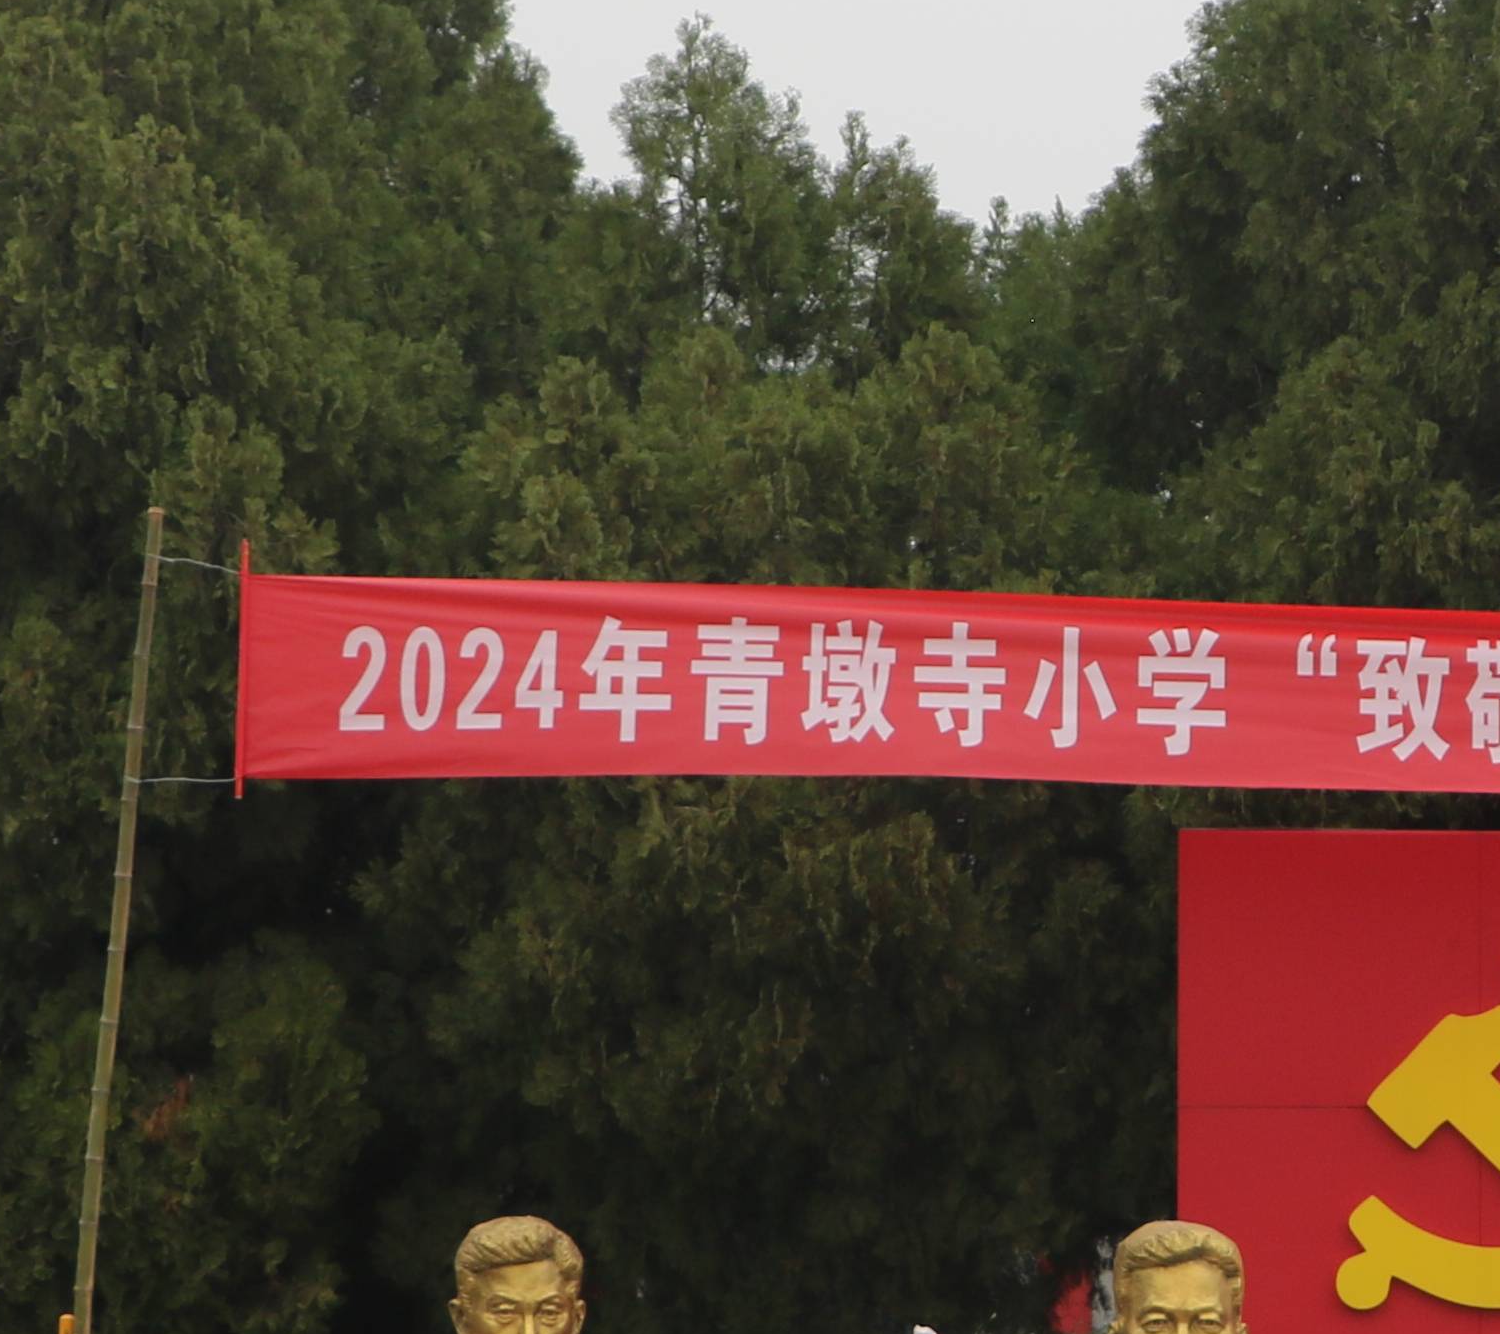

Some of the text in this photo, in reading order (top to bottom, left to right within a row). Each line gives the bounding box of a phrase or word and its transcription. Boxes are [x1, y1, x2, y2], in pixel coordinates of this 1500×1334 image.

[339, 616, 1227, 756] 2024年青墩寺小学
